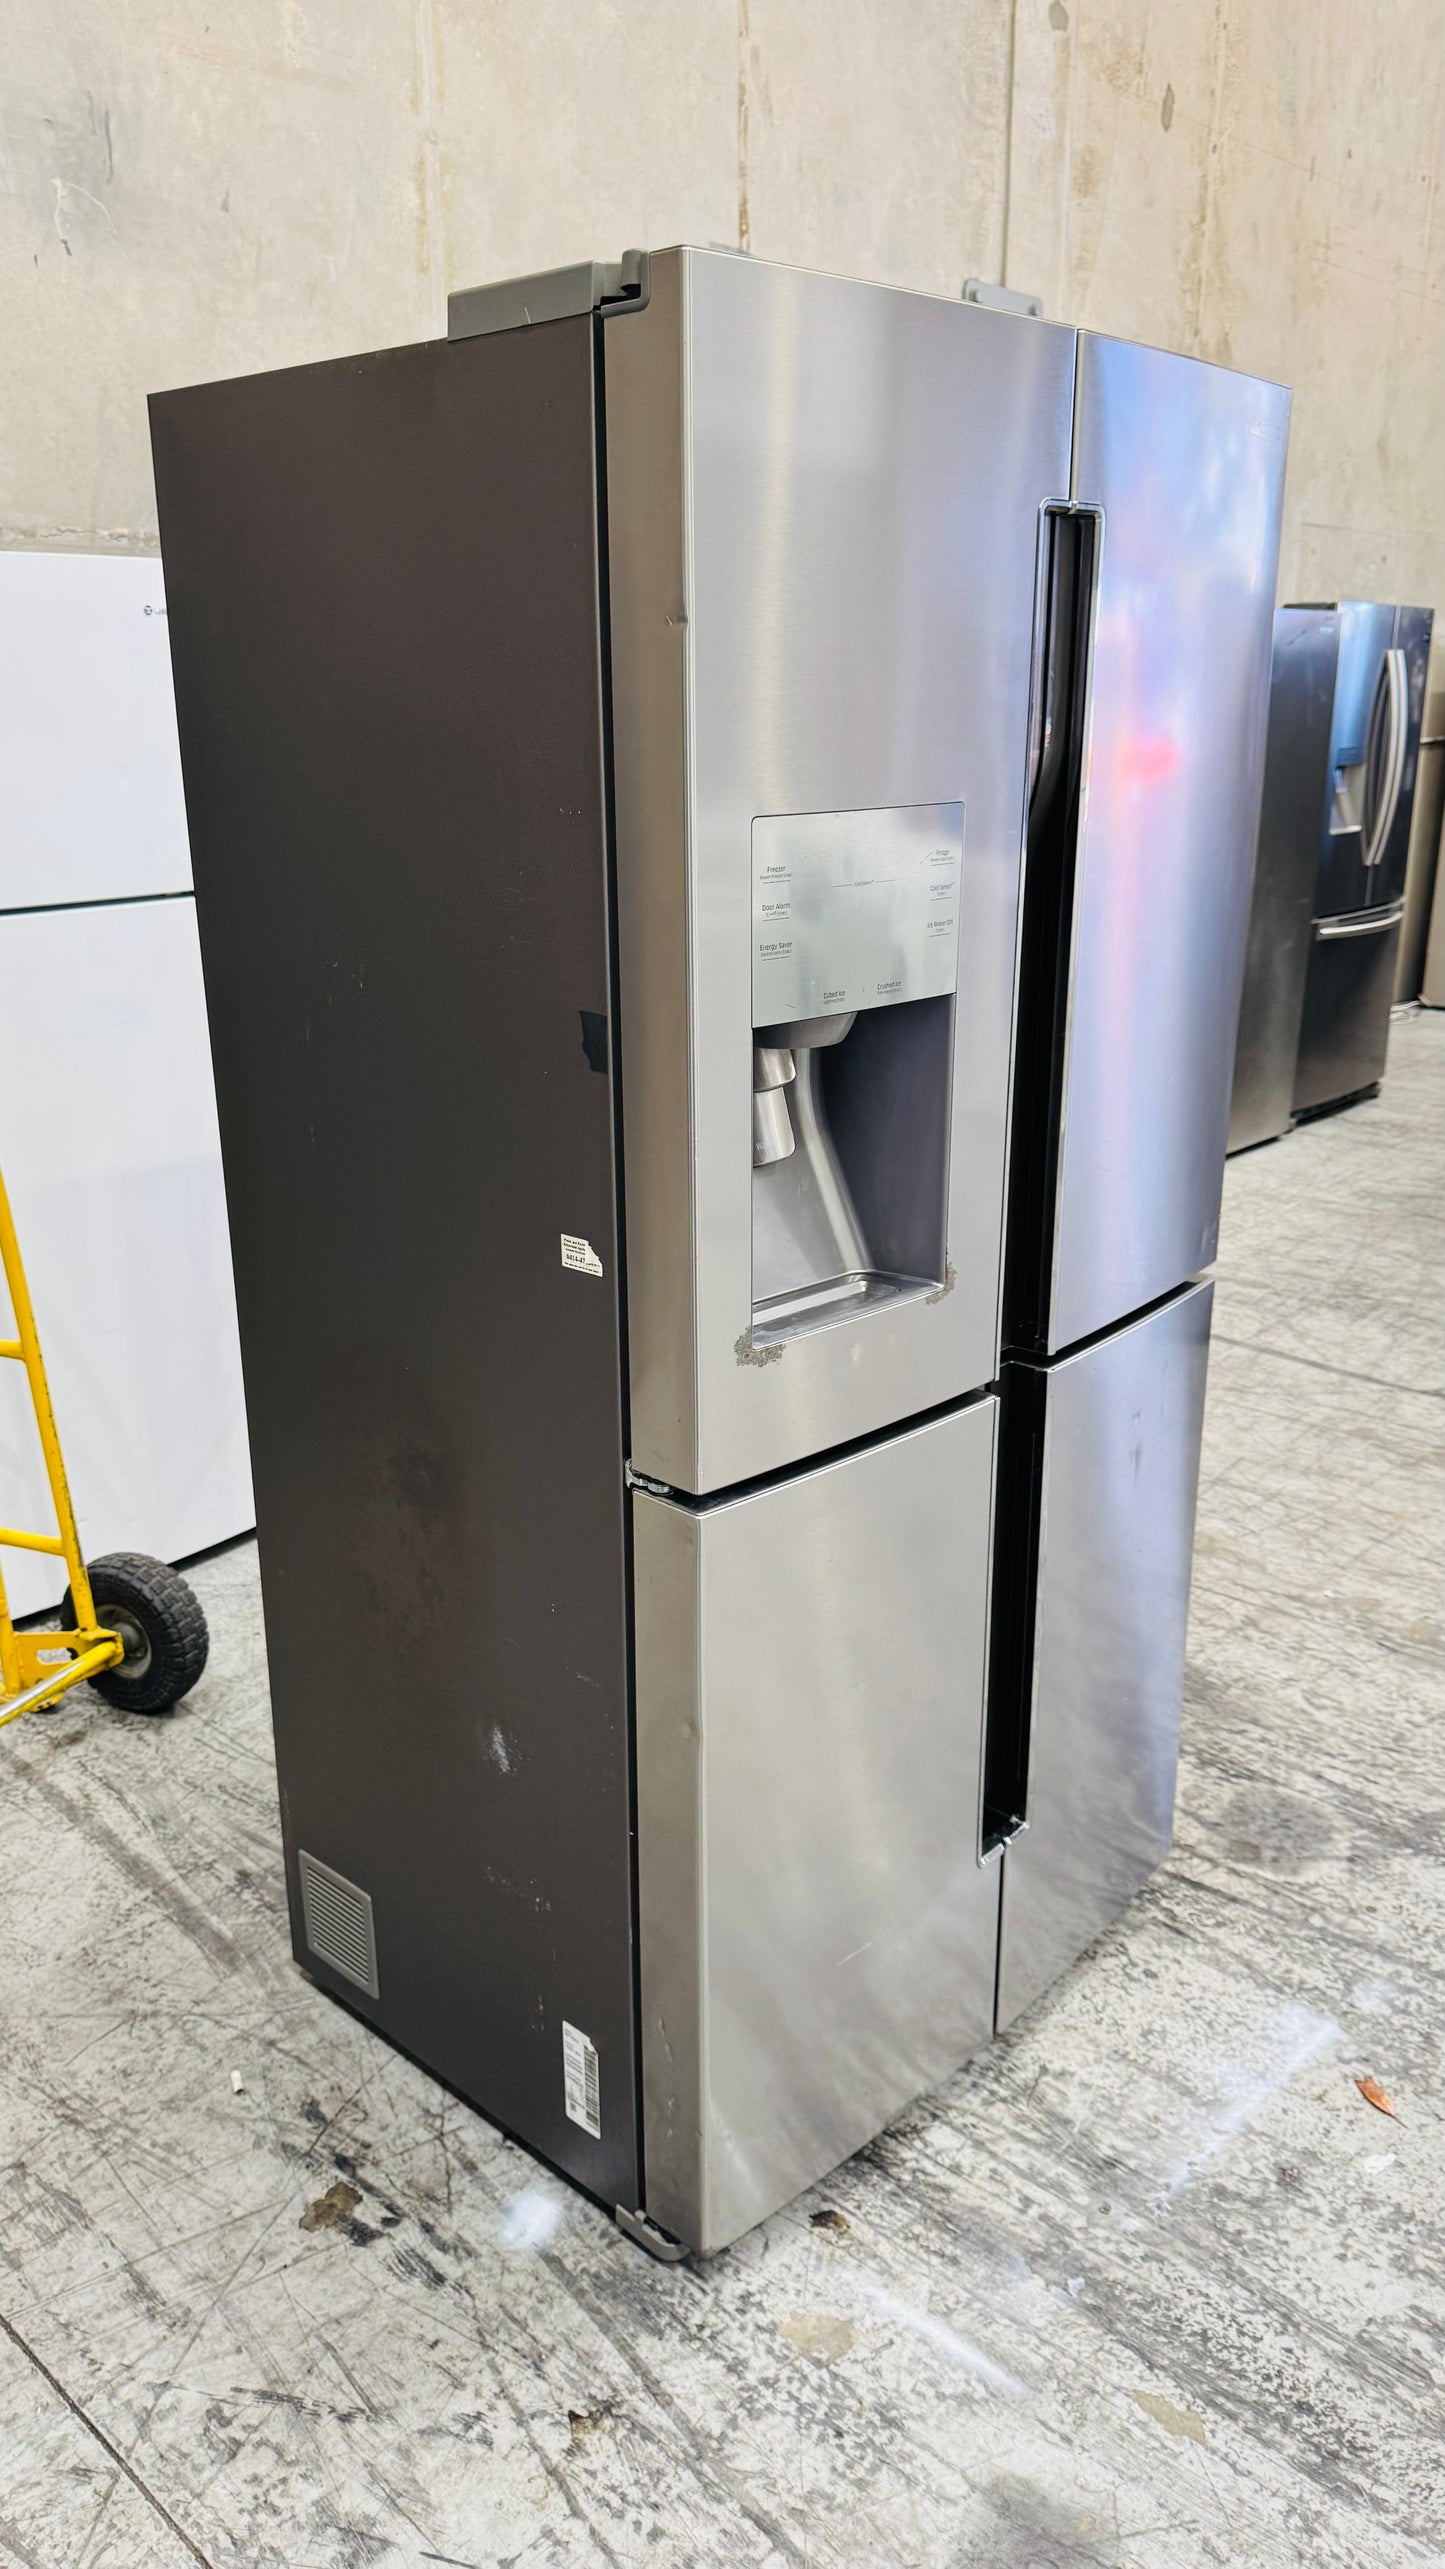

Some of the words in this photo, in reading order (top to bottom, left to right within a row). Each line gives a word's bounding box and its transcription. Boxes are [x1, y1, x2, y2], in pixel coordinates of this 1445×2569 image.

[760, 943, 778, 952] Energy
[778, 941, 793, 949] Saver
[877, 982, 895, 990] Crushed
[823, 991, 838, 999] Cubed
